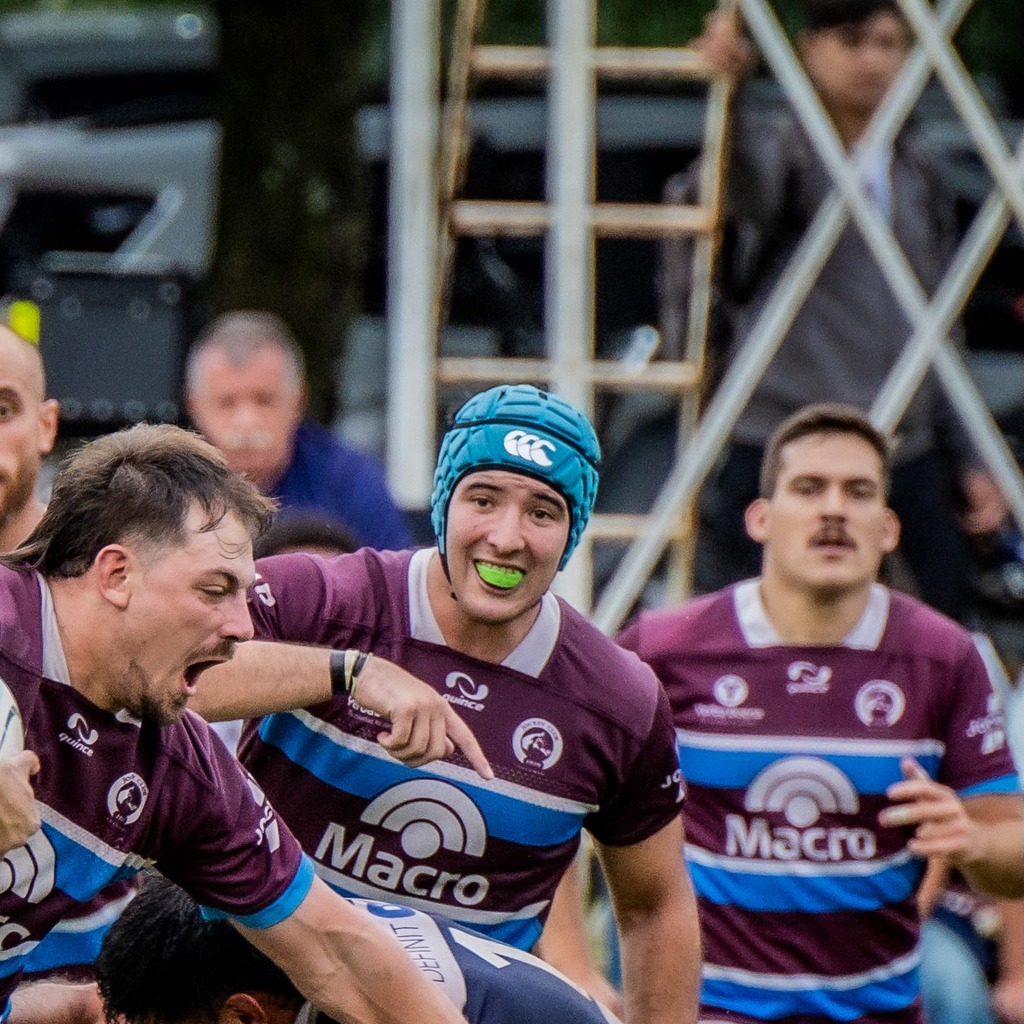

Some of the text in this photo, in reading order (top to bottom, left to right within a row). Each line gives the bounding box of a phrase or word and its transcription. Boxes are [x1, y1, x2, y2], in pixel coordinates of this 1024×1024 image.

[58, 732, 94, 757] quince
[726, 813, 877, 861] Macro
[314, 822, 490, 906] Macro
